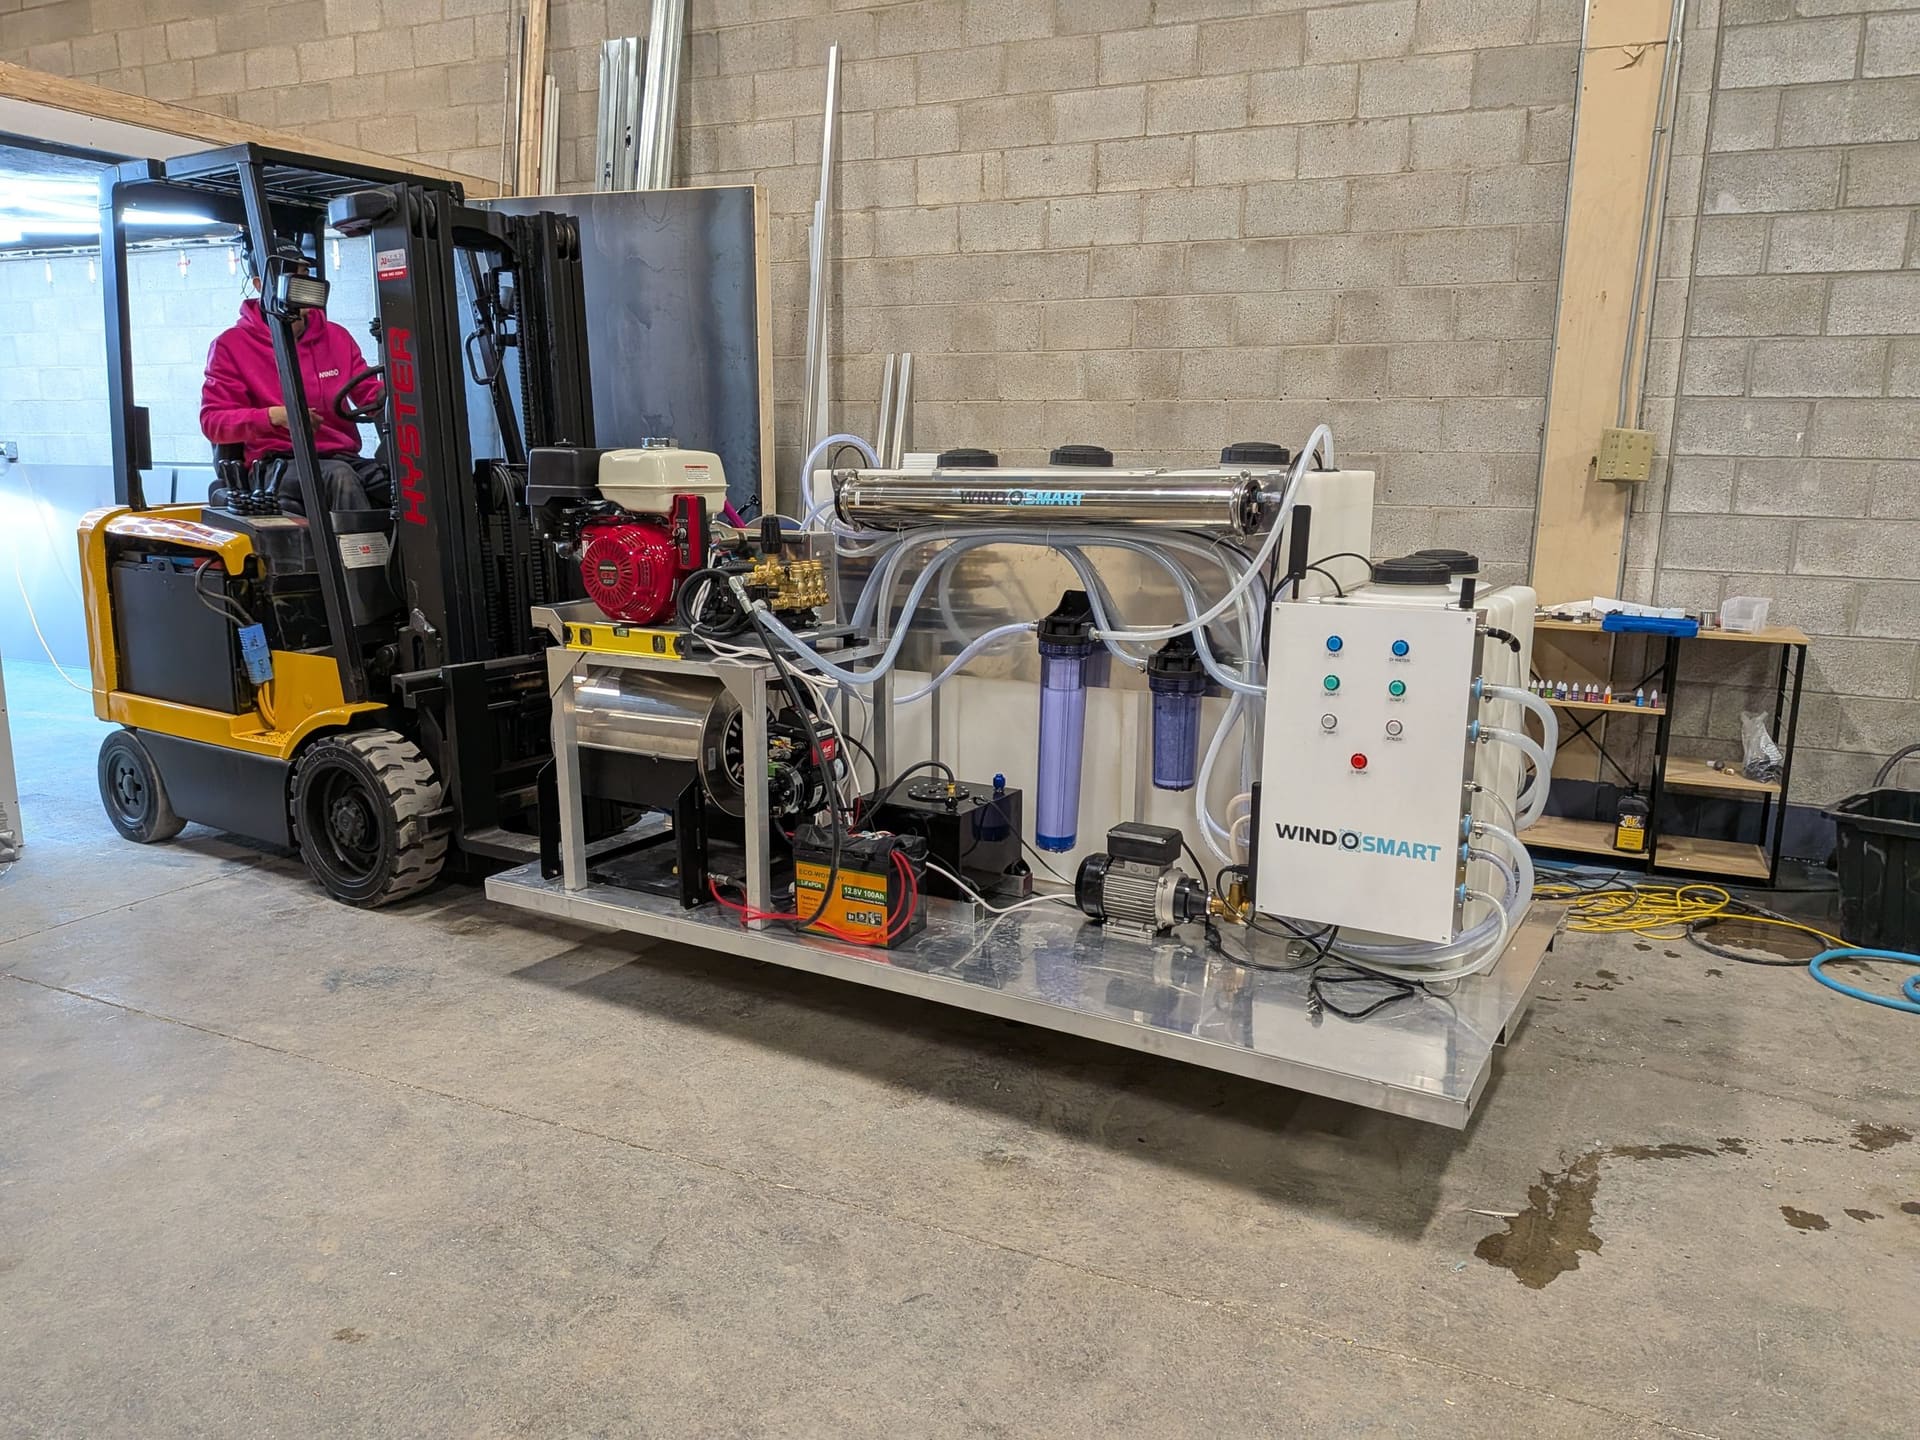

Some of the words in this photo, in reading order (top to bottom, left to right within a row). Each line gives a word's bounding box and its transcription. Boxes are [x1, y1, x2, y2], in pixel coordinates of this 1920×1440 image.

[388, 327, 428, 526] HYSTER
[1275, 822, 1442, 862] WINDOSMART
[844, 886, 863, 896] 12.8V
[863, 889, 885, 900] 100Ah
